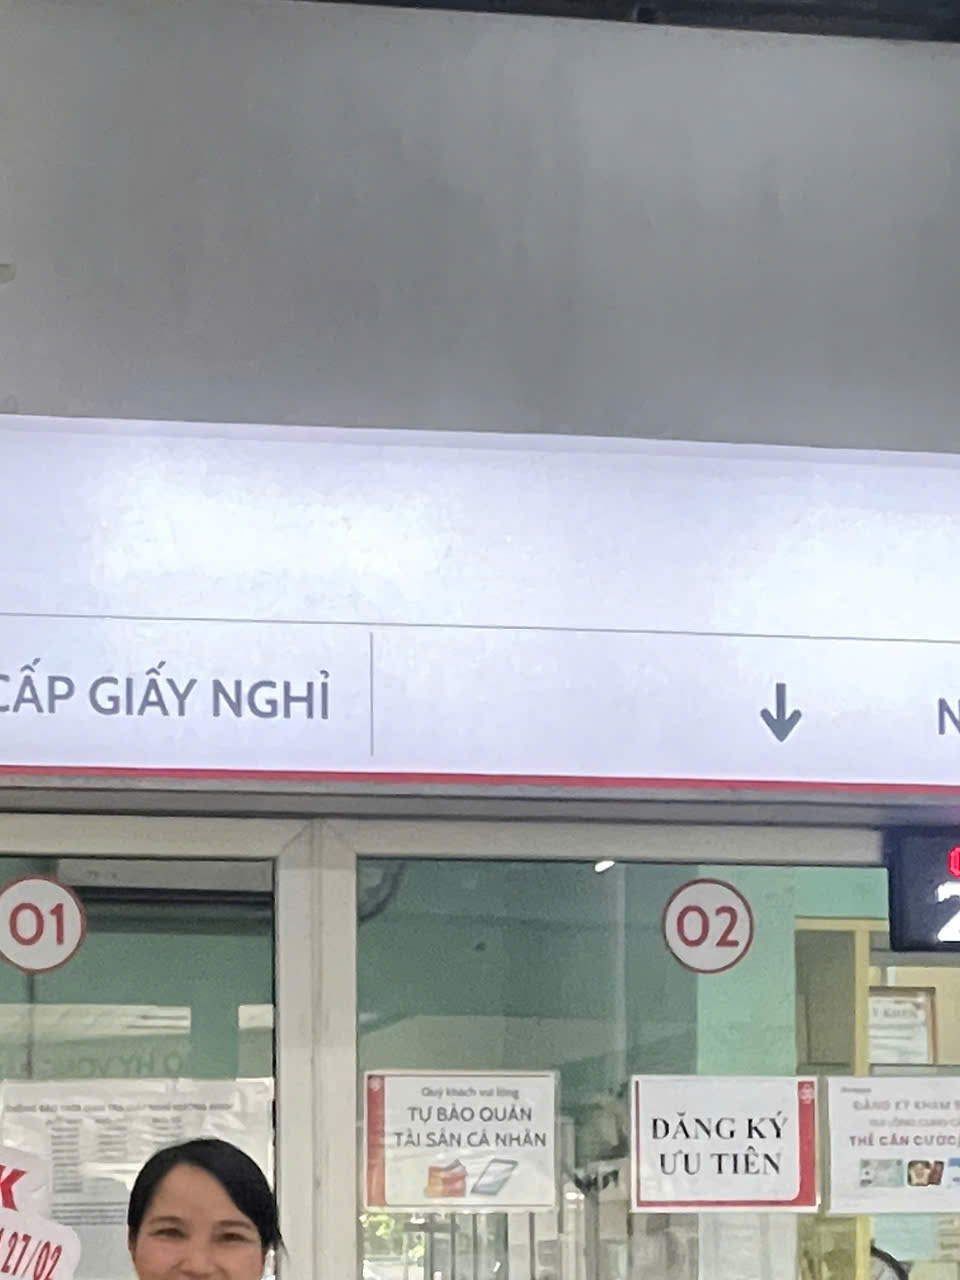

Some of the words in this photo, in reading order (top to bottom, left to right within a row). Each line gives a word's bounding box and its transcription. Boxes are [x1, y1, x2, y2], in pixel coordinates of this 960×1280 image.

[89, 661, 197, 716] GIẤY
[212, 669, 330, 719] NGHỈ
[9, 902, 65, 946] 01
[677, 905, 740, 947] 02
[408, 1105, 432, 1125] TỰ
[747, 1110, 788, 1139] KÝ
[495, 1128, 546, 1147] NHÂN
[660, 1149, 702, 1175] ƯU
[710, 1145, 782, 1175] TIÊN
